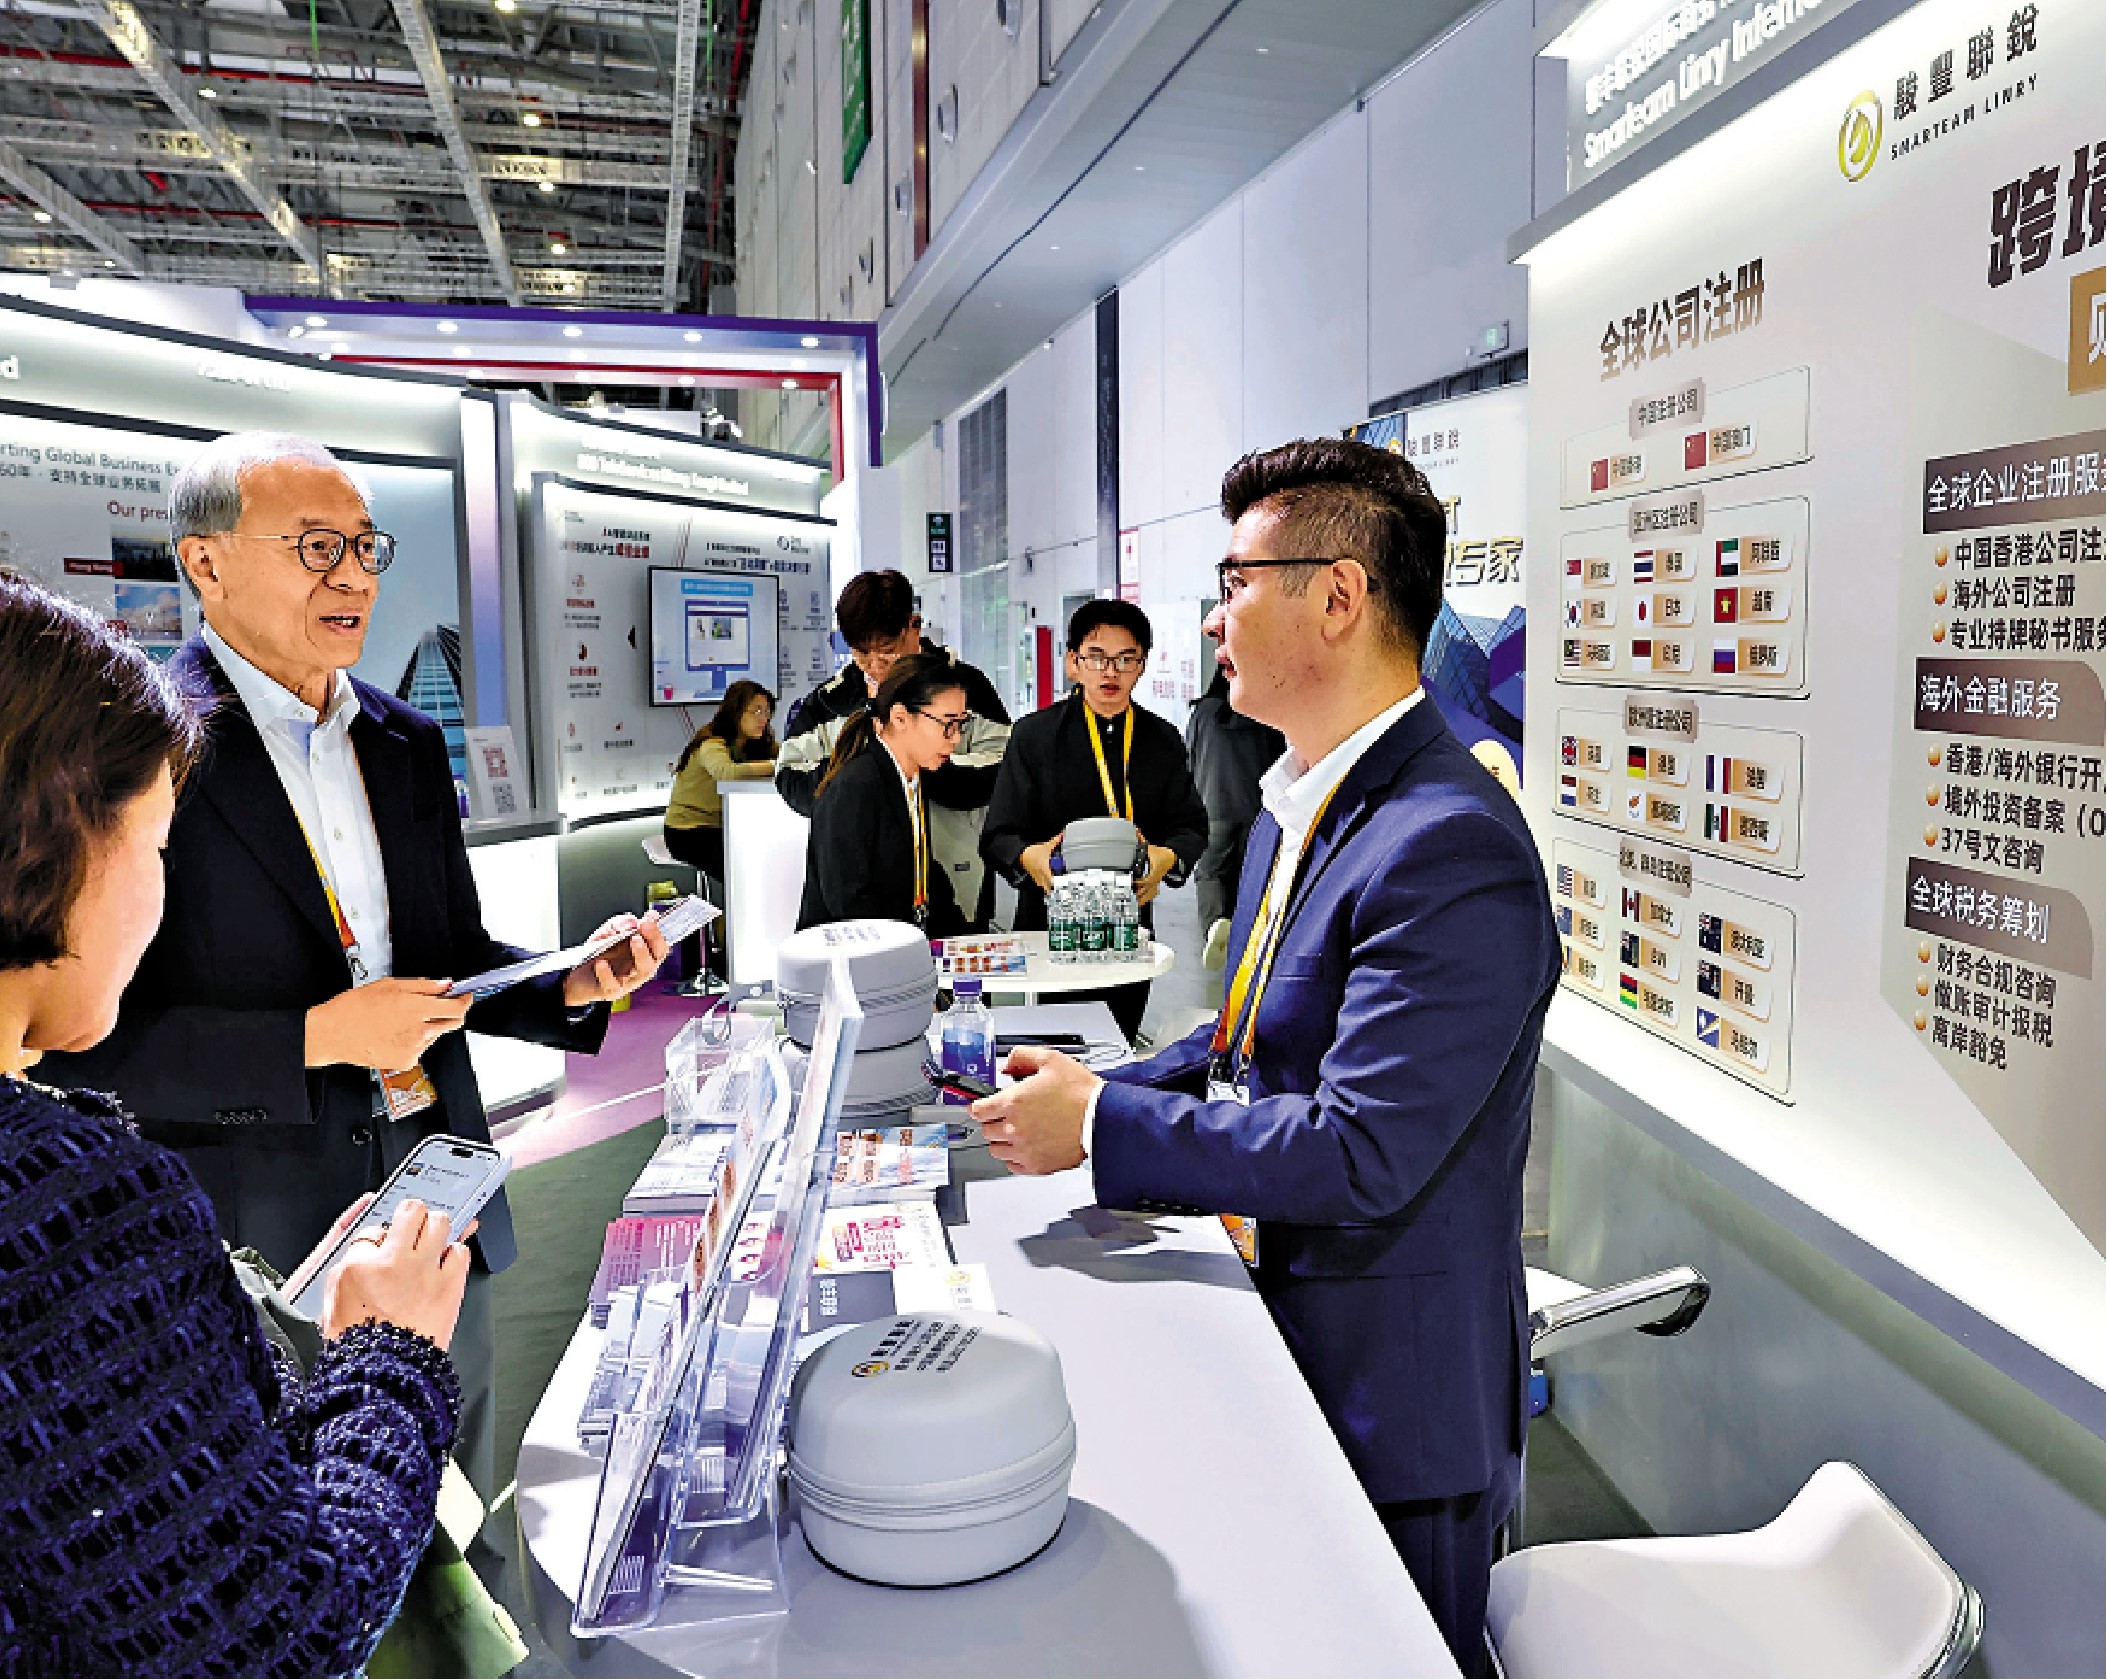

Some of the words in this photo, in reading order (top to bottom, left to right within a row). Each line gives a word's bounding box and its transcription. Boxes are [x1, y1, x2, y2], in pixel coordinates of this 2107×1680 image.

[1893, 3, 2040, 119] 駿豐聯銳
[1584, 79, 1677, 168] Smarteam
[1891, 104, 1976, 160] SMARTEAM
[1984, 73, 2039, 115] LINRY
[1599, 256, 1765, 382] 全球公司注册
[45, 447, 96, 466] Global
[100, 453, 161, 474] Business
[1928, 452, 2105, 512] 全球企业注册服
[107, 500, 136, 518] Our
[1955, 526, 2105, 570] 中国香港公司注
[1952, 573, 2076, 611] 海外公司注册
[1920, 673, 2062, 720] 海外金融服务
[1946, 743, 2105, 793] 香港/海外银行开
[1941, 827, 2045, 875] 37号文咨询
[1910, 874, 2049, 944] 全球税务筹划
[1937, 942, 2057, 1009] 财务合规咨询
[1934, 976, 2054, 1048] 做账审计报税
[1932, 1015, 2007, 1071] 离岸豁免
